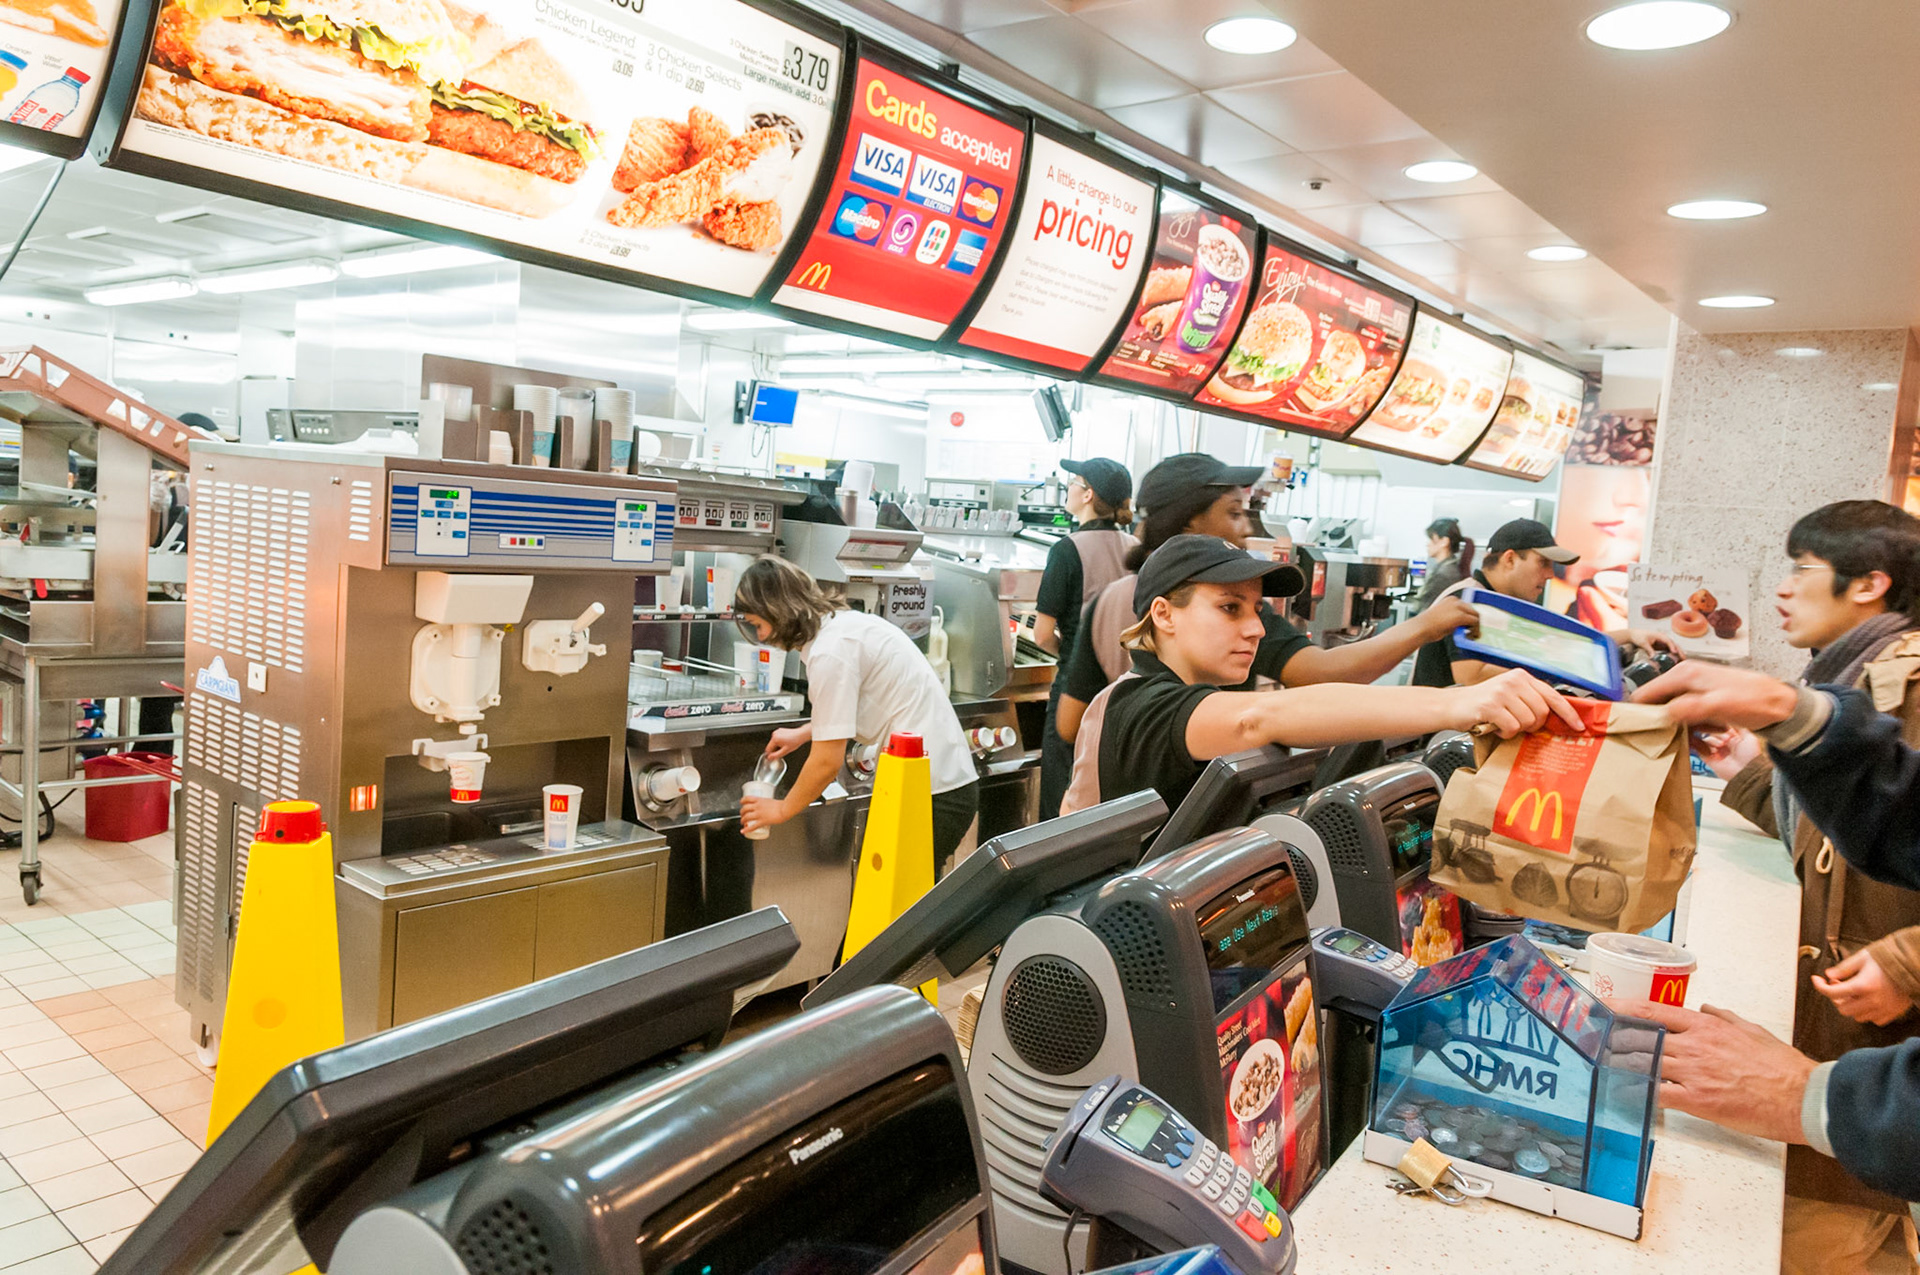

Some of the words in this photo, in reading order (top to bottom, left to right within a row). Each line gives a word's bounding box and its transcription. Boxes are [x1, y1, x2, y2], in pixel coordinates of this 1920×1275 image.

[535, 0, 588, 29] Chicken
[590, 19, 637, 49] Legend
[657, 47, 702, 76] Chicken
[704, 65, 743, 91] Selects
[665, 66, 684, 84] dip
[744, 65, 768, 83] Large
[769, 77, 793, 95] meals
[795, 87, 811, 101] add
[782, 46, 830, 91] £3.79
[865, 79, 937, 139] Cards
[940, 126, 1012, 170] accepted
[864, 141, 905, 179] VISA
[919, 163, 957, 198] VISA
[1046, 165, 1055, 180] A
[1056, 168, 1077, 192] little
[1078, 180, 1111, 206] change
[1113, 195, 1123, 210] to
[1123, 201, 1138, 216] our
[840, 208, 880, 230] Maestro
[1034, 198, 1133, 270] pricing
[1630, 566, 1641, 582] So
[892, 600, 925, 614] ground
[691, 704, 712, 714] zero
[745, 701, 765, 711] zero
[1245, 914, 1260, 933] Next
[789, 1127, 844, 1165] Panasonic
[1252, 1119, 1277, 1156] Quality
[1190, 1172, 1200, 1181] 1
[1200, 1159, 1210, 1169] 2
[1205, 1145, 1216, 1155] 3
[1207, 1185, 1218, 1195] 4
[1216, 1172, 1227, 1182] 5
[1222, 1158, 1233, 1168] 6
[1255, 1140, 1277, 1177] Street
[1224, 1200, 1235, 1211] 7
[1233, 1187, 1245, 1198] 8
[1239, 1172, 1249, 1183] 9
[1251, 1203, 1262, 1214] 0
